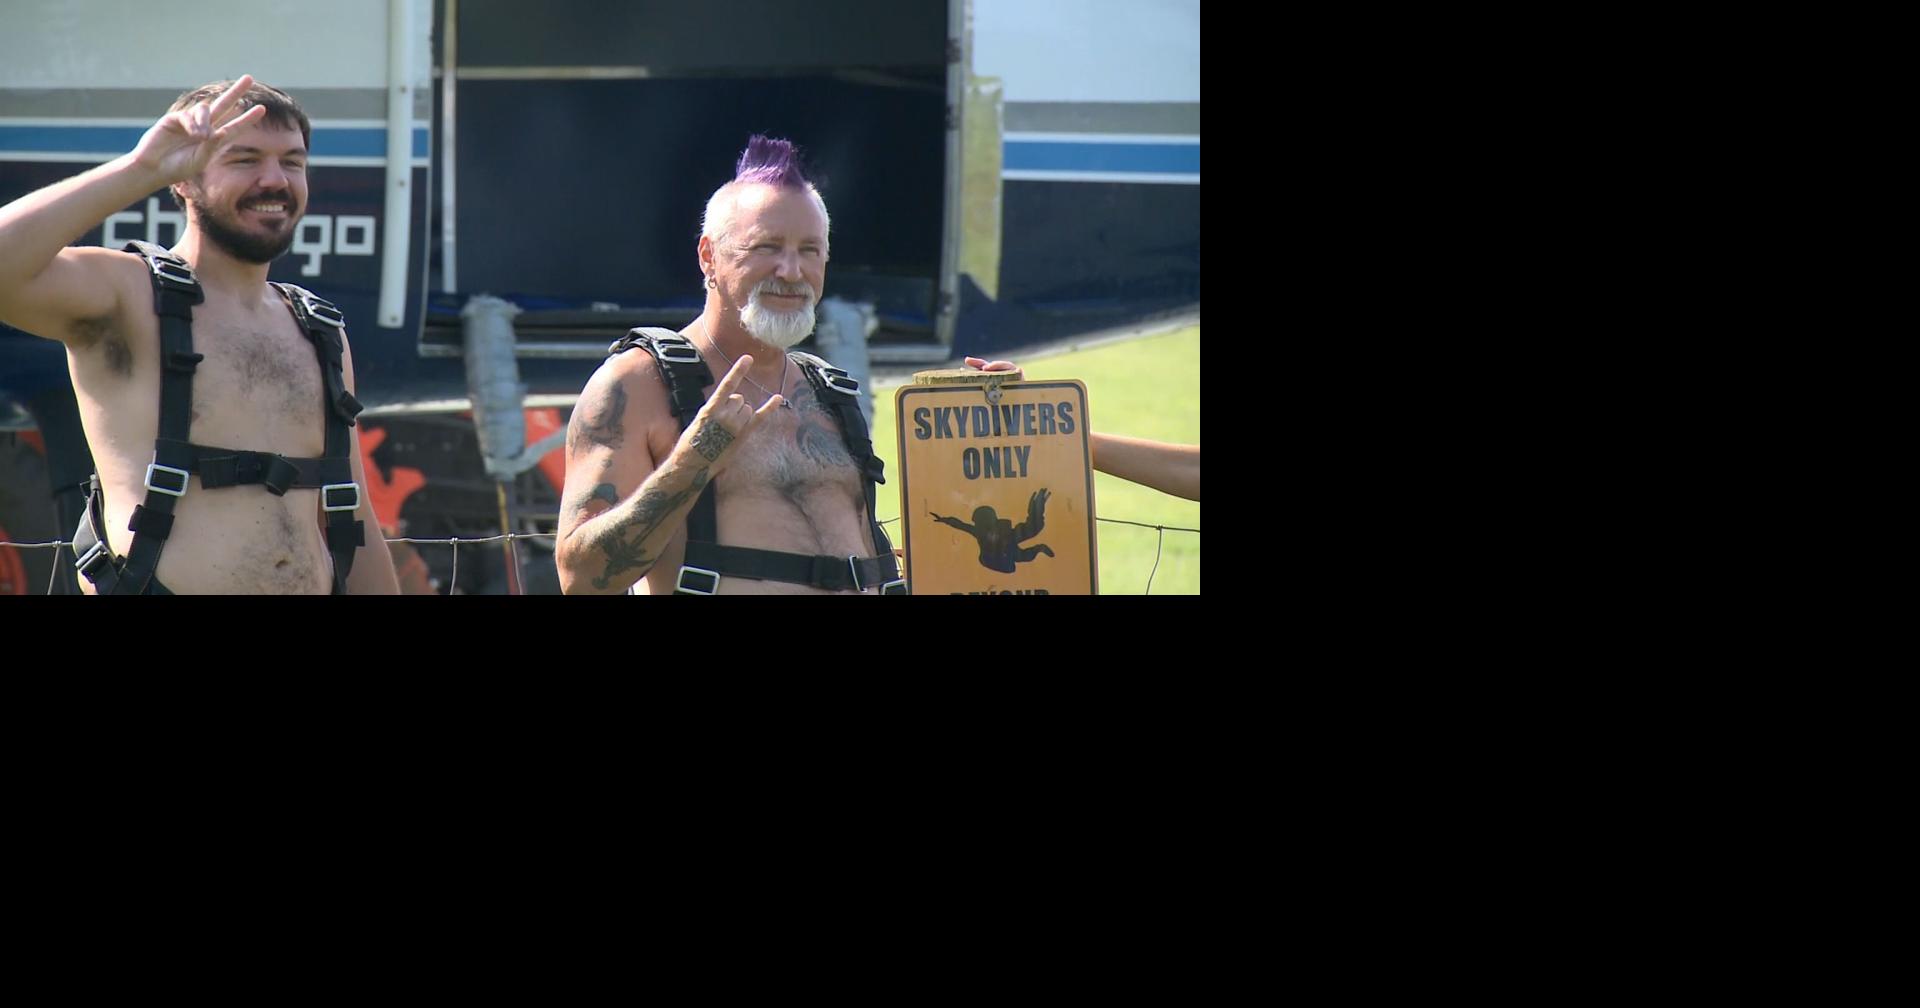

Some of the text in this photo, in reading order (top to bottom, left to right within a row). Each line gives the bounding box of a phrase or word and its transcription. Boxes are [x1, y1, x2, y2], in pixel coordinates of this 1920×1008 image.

[104, 197, 375, 277] chgo
[914, 401, 1076, 440] SKYDIVERS
[962, 445, 1032, 480] ONLY
